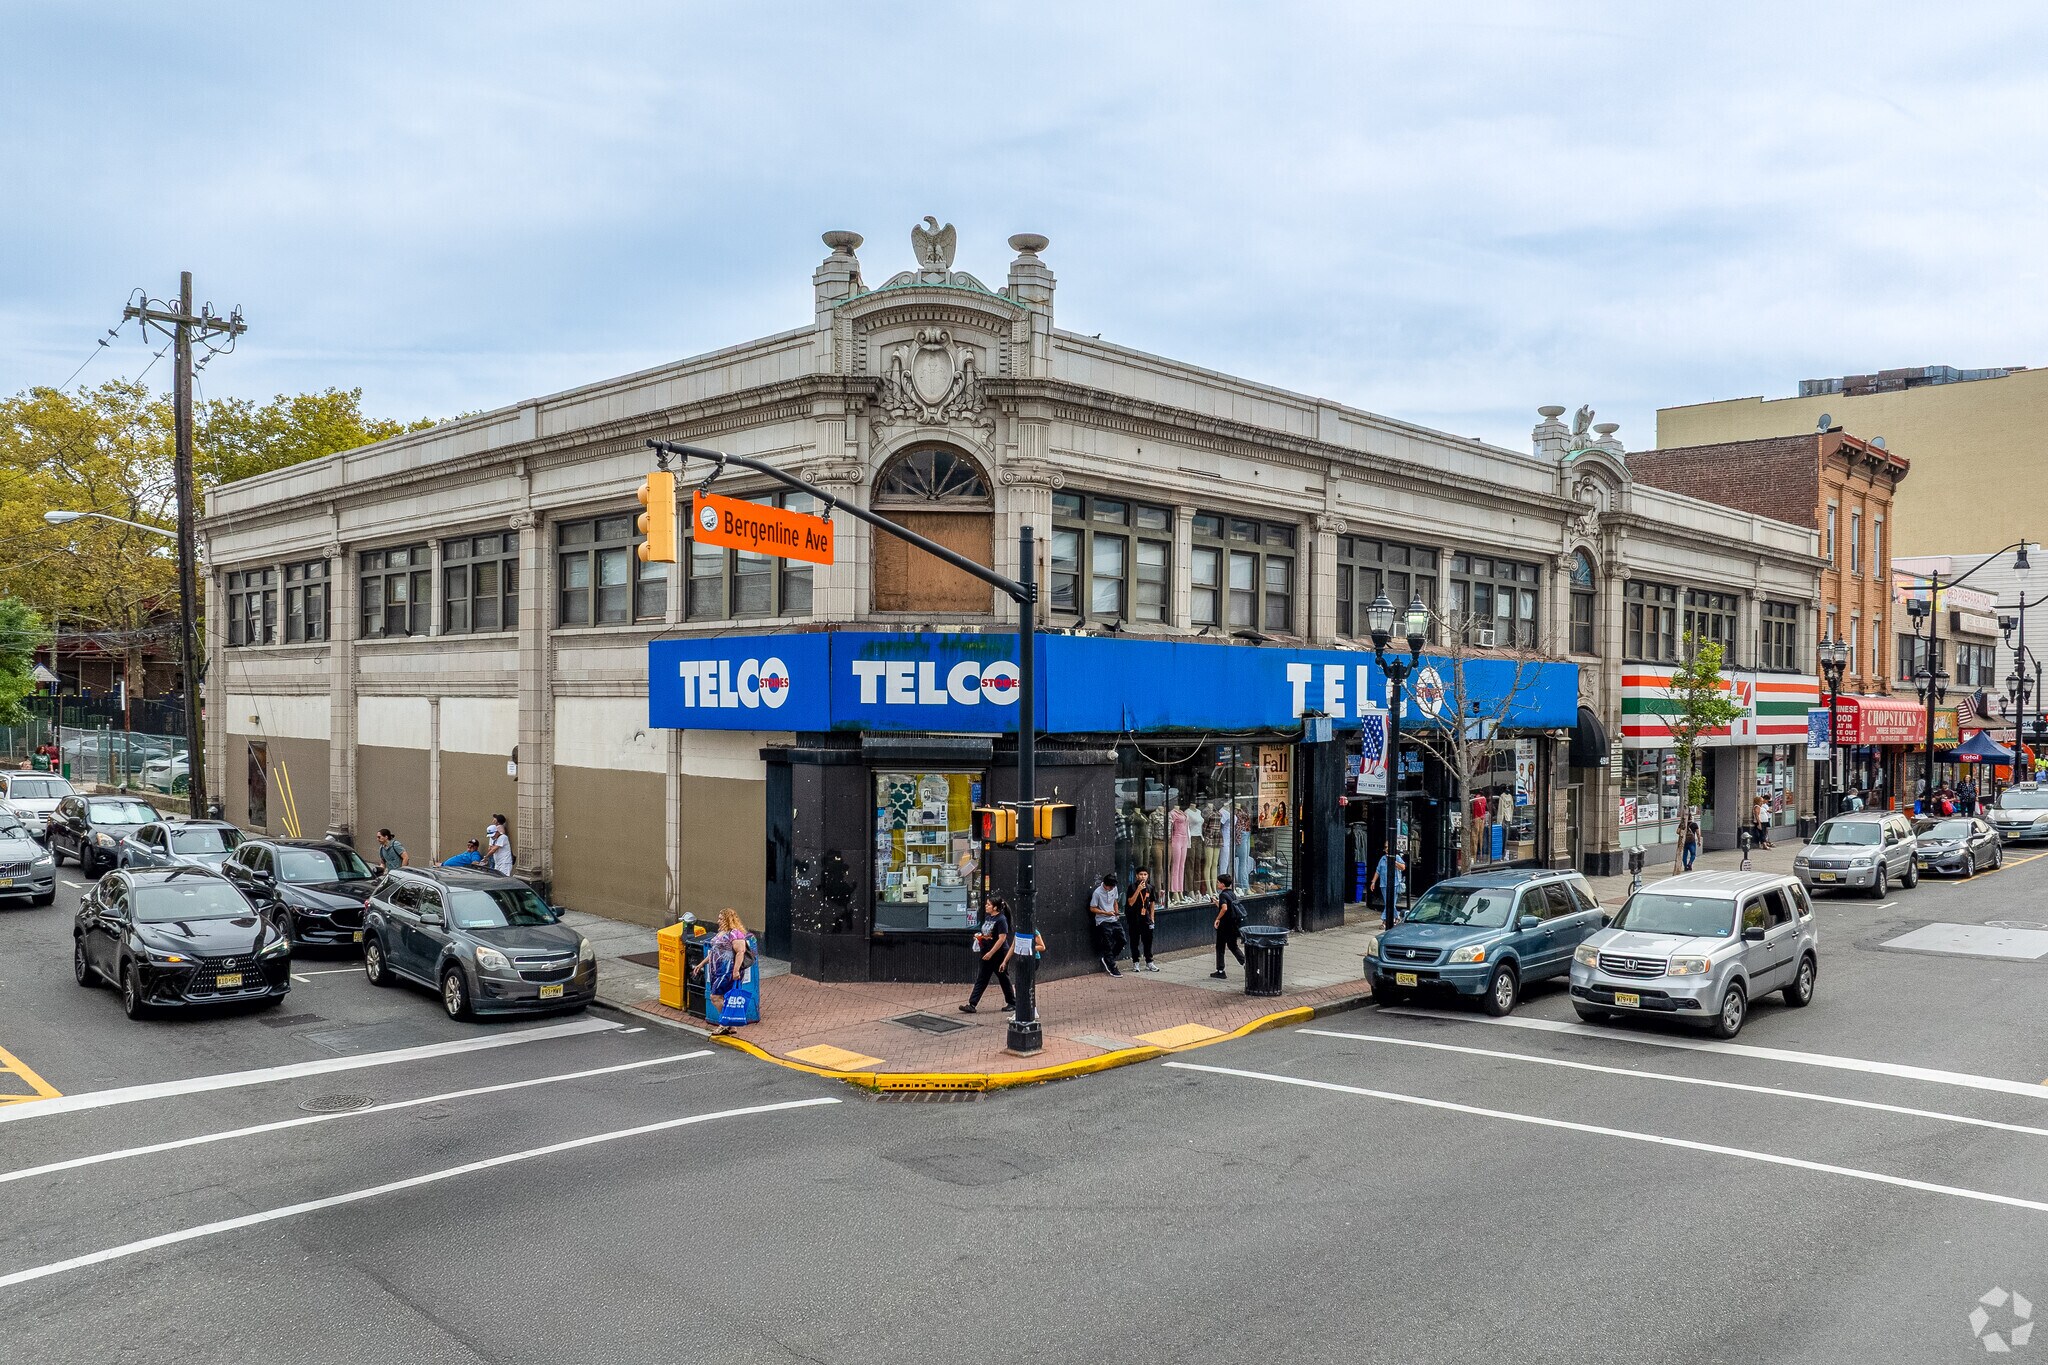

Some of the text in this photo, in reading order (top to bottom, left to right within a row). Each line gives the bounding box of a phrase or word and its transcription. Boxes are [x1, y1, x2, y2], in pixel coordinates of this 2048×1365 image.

[724, 511, 828, 552] Bergenline Ave
[679, 657, 789, 709] TELCO
[759, 677, 789, 688] STORES
[852, 660, 1020, 706] TELCO
[1837, 714, 1853, 722] OOD
[1867, 710, 1916, 727] CHOPSTICKS
[1263, 753, 1288, 773] Fall
